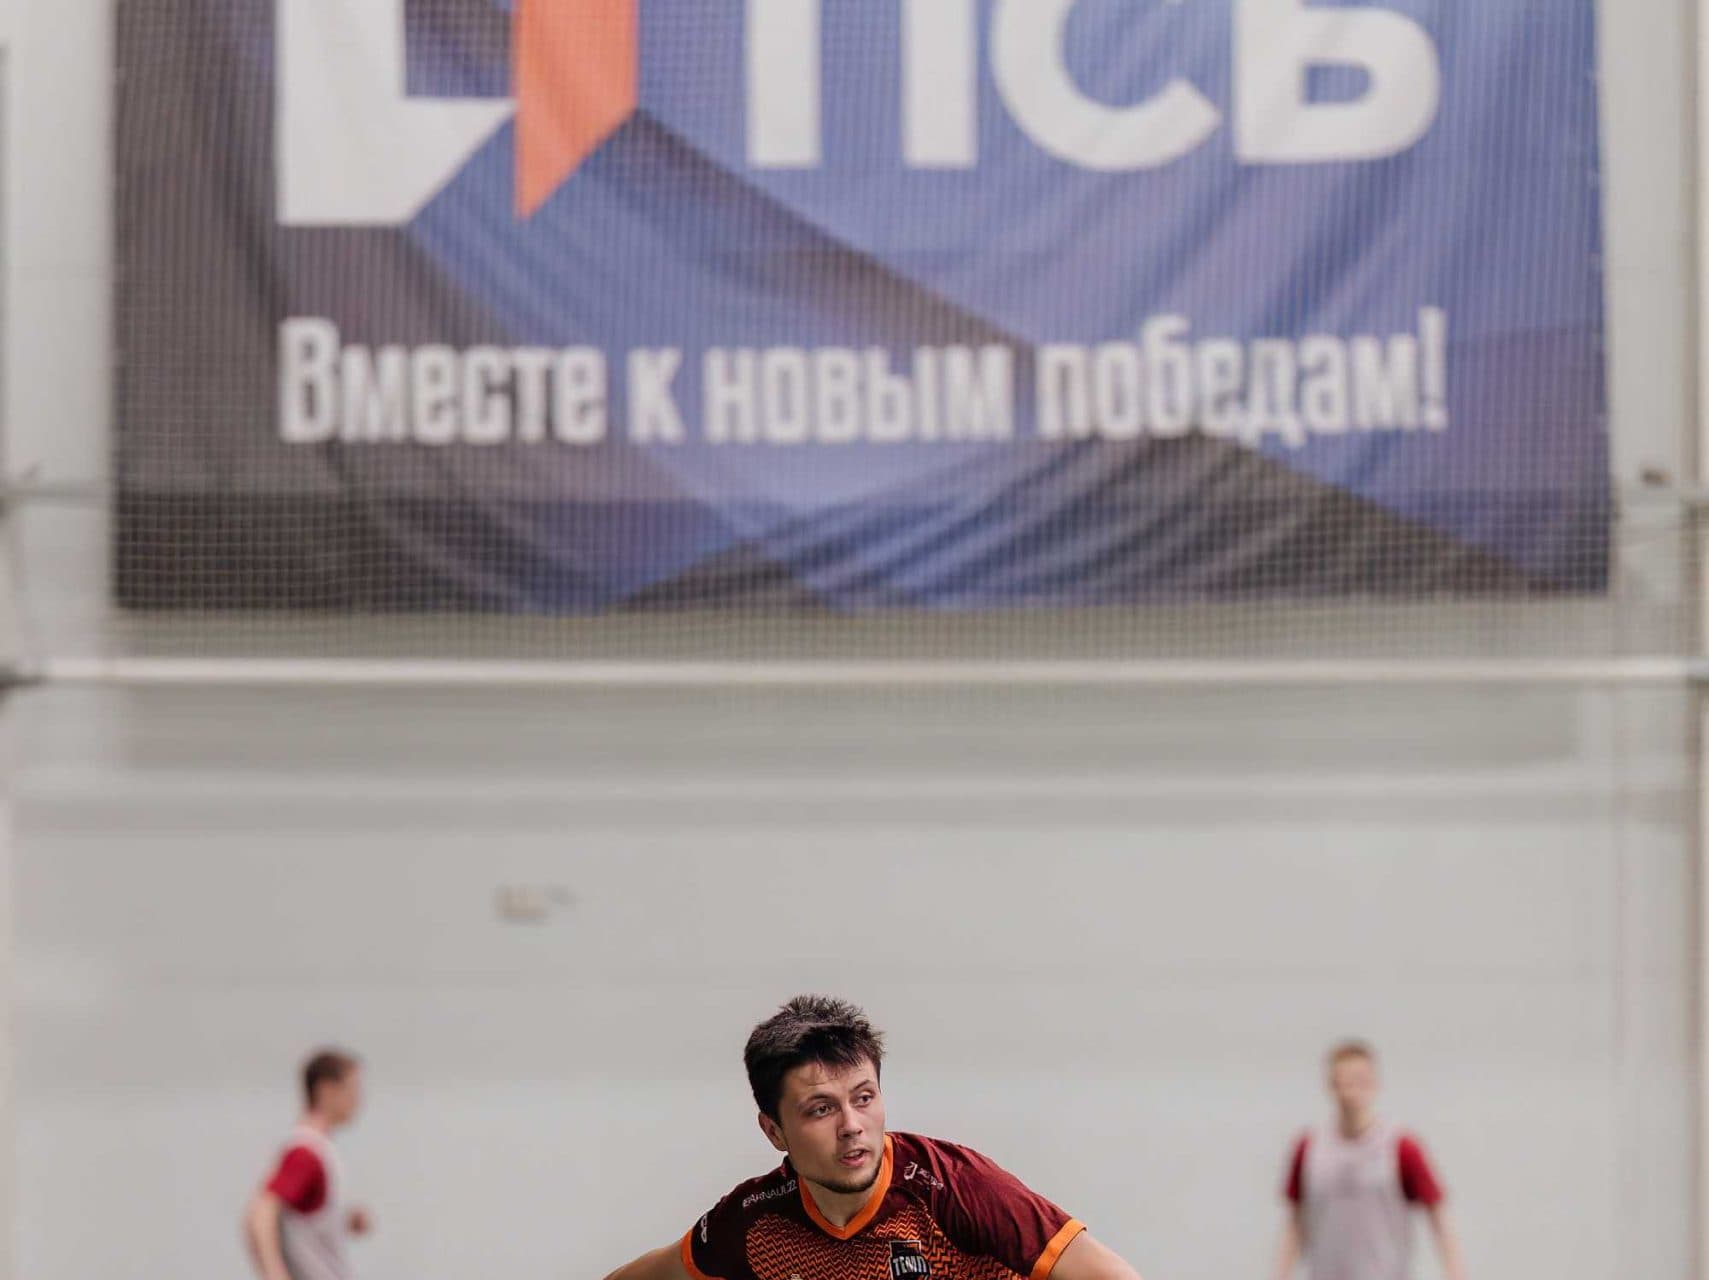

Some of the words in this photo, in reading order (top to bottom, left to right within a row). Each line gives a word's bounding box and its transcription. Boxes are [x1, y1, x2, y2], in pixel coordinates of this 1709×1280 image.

[278, 316, 607, 445] Вместе
[626, 346, 686, 444] к
[704, 343, 1014, 443] новым
[1035, 305, 1449, 447] победам!
[893, 1255, 928, 1277] ТЕМП
